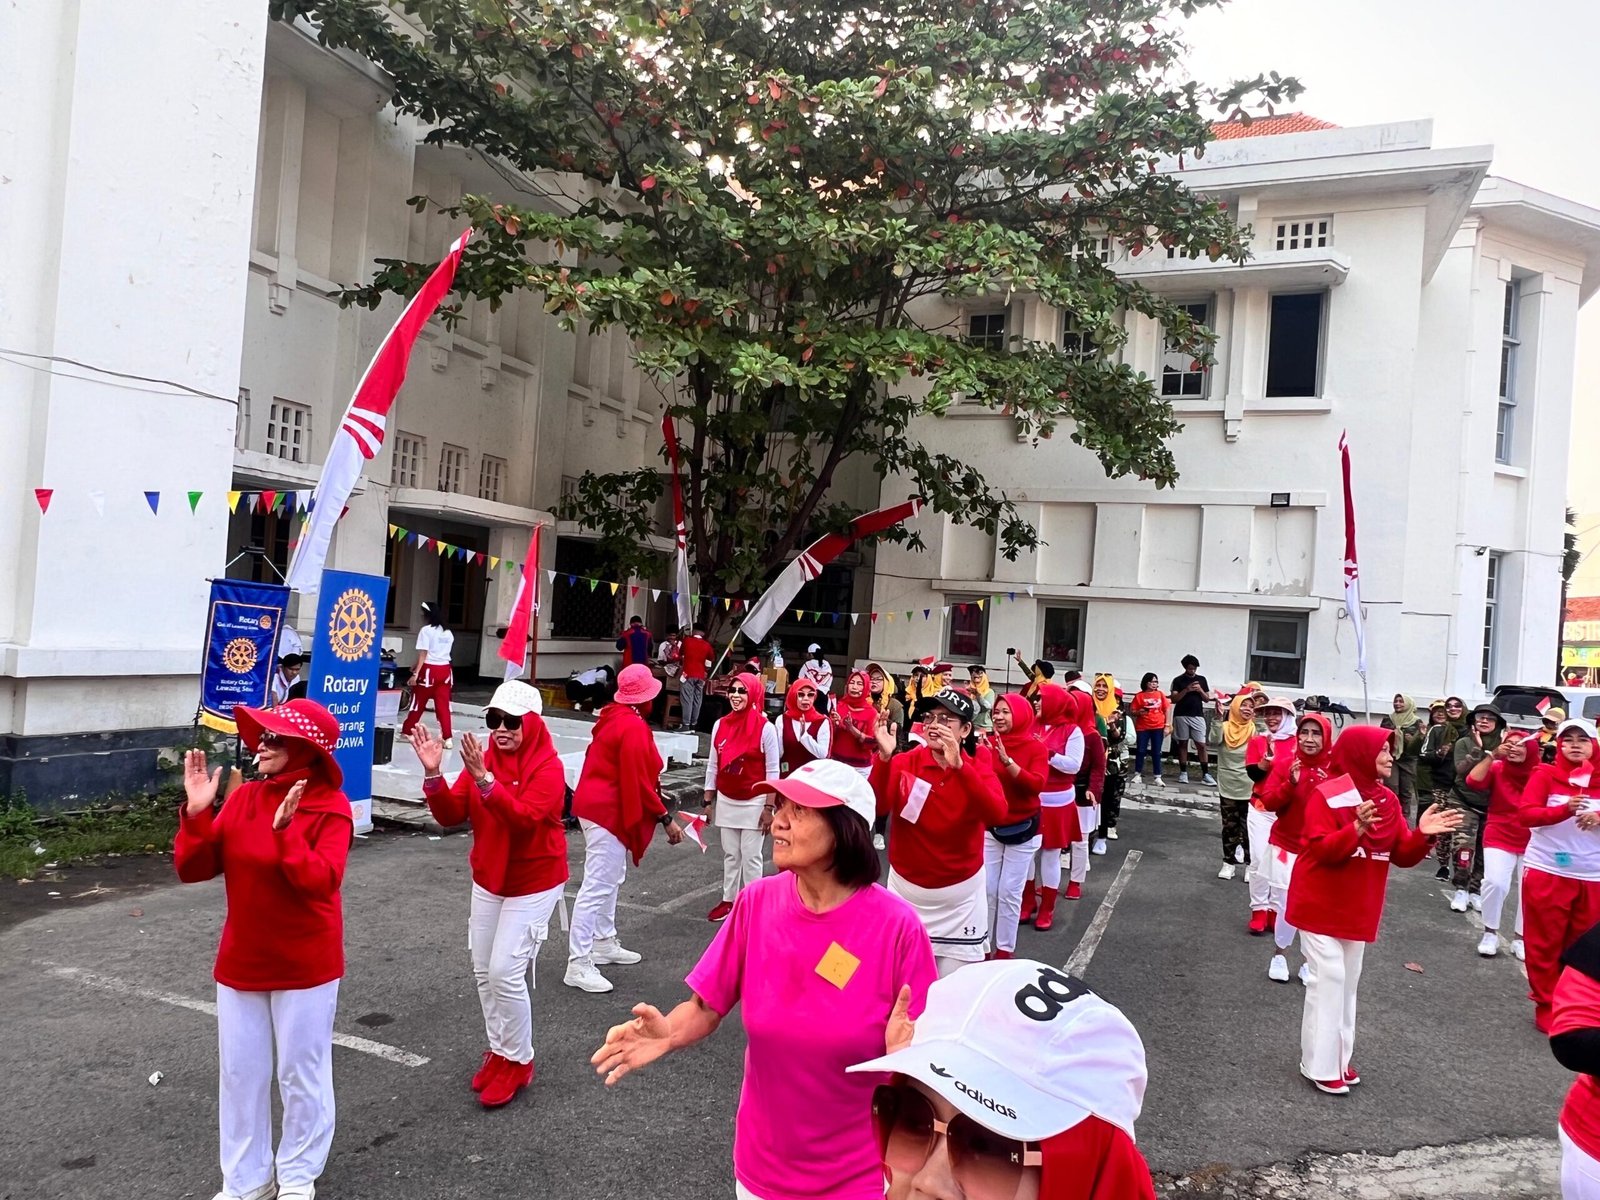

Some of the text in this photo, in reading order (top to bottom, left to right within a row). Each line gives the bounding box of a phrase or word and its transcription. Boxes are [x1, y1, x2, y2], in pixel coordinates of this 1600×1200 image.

[323, 674, 369, 696] Rotary
[327, 701, 361, 715] Club of
[339, 721, 365, 734] arang
[336, 736, 364, 749] DAWA
[954, 1080, 1018, 1120] adidas
